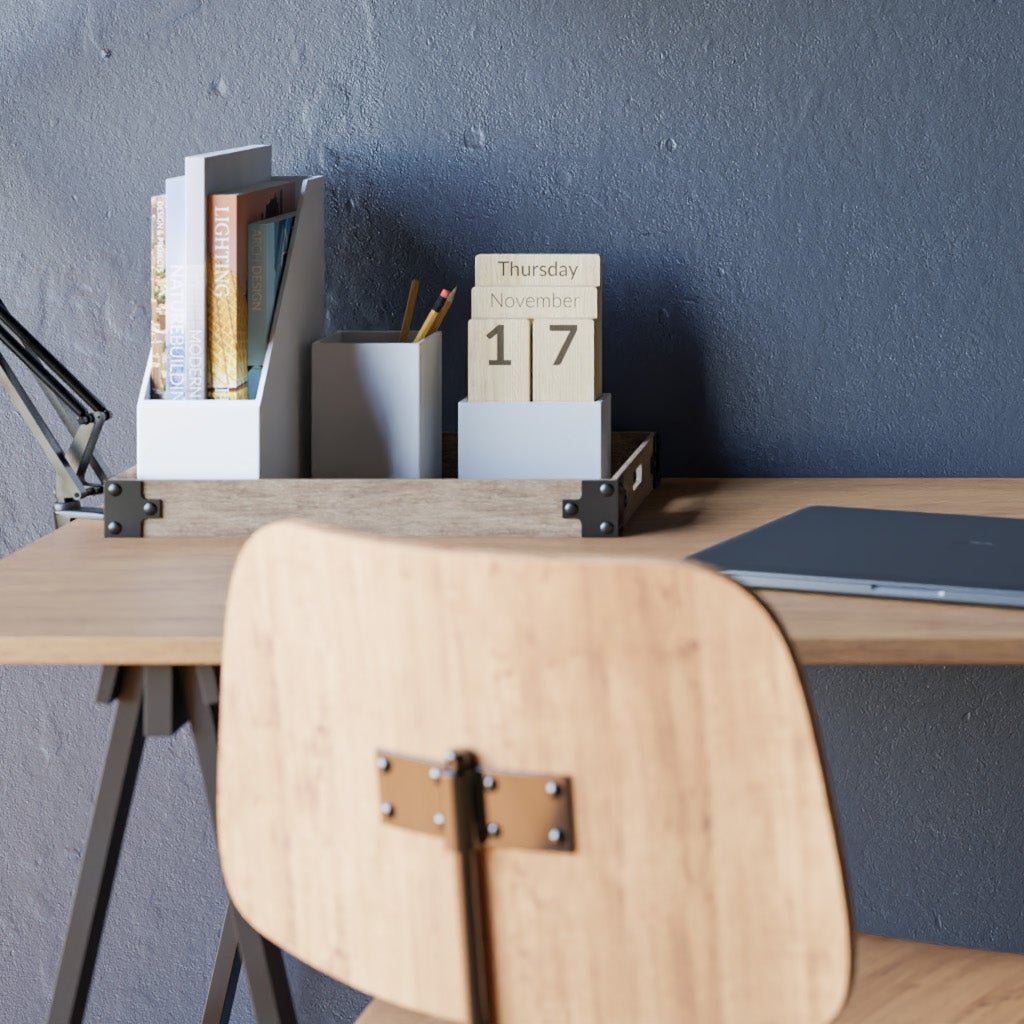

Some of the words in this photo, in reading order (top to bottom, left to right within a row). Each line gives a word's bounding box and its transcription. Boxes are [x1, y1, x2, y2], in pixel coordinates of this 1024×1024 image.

[156, 200, 165, 229] DESIGN
[213, 206, 230, 298] LIGHTING
[497, 261, 579, 280] Thursday
[251, 265, 263, 311] DESIGN
[490, 292, 580, 309] November
[187, 329, 202, 399] MODERN
